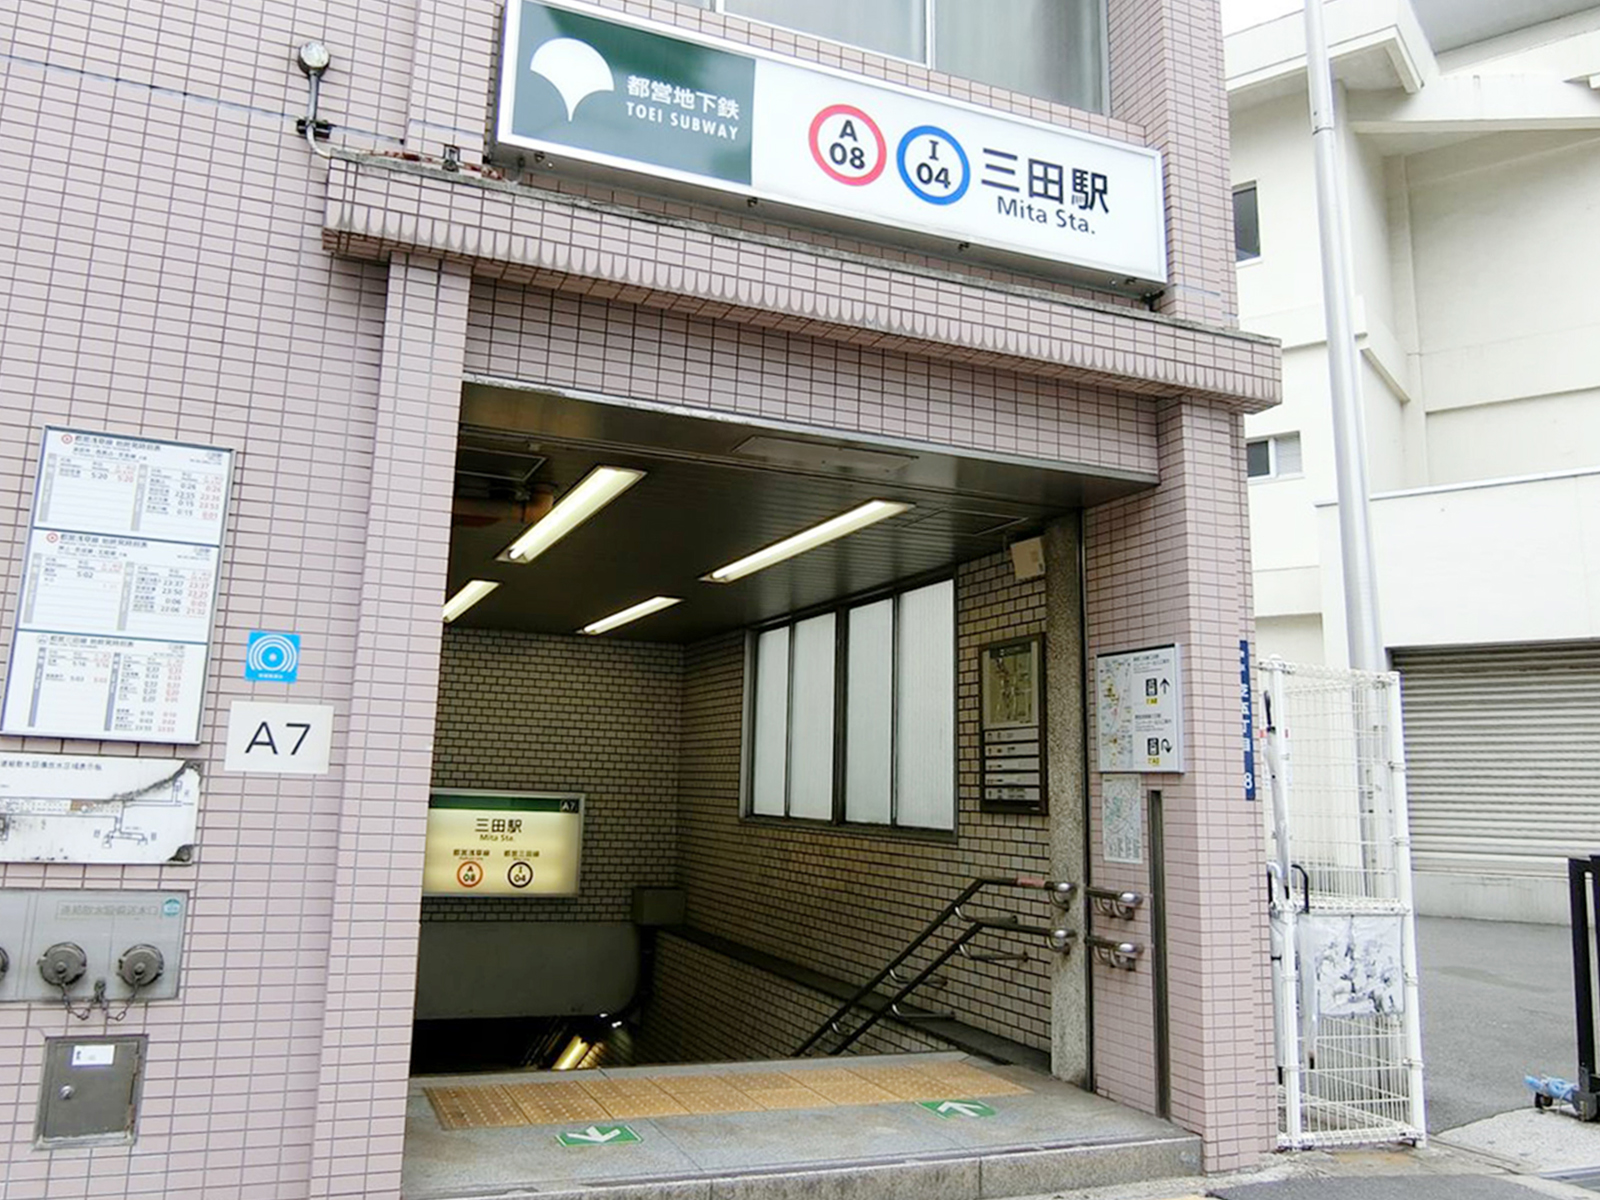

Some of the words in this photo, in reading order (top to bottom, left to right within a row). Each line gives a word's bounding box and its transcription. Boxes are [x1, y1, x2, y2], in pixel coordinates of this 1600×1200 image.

[627, 75, 740, 120] 都営地下鉄
[626, 101, 663, 123] TOEI
[670, 112, 739, 140] SUBWAY
[839, 119, 858, 142] A
[829, 142, 866, 170] 08
[928, 140, 940, 161] I
[916, 162, 951, 189] 04
[981, 147, 1110, 214] 三田駅
[997, 195, 1048, 224] Mita
[1055, 208, 1096, 235] Sta.
[244, 721, 311, 756] A7
[561, 802, 576, 811] A7
[475, 818, 522, 833] 三田駅
[479, 833, 498, 842] Mita
